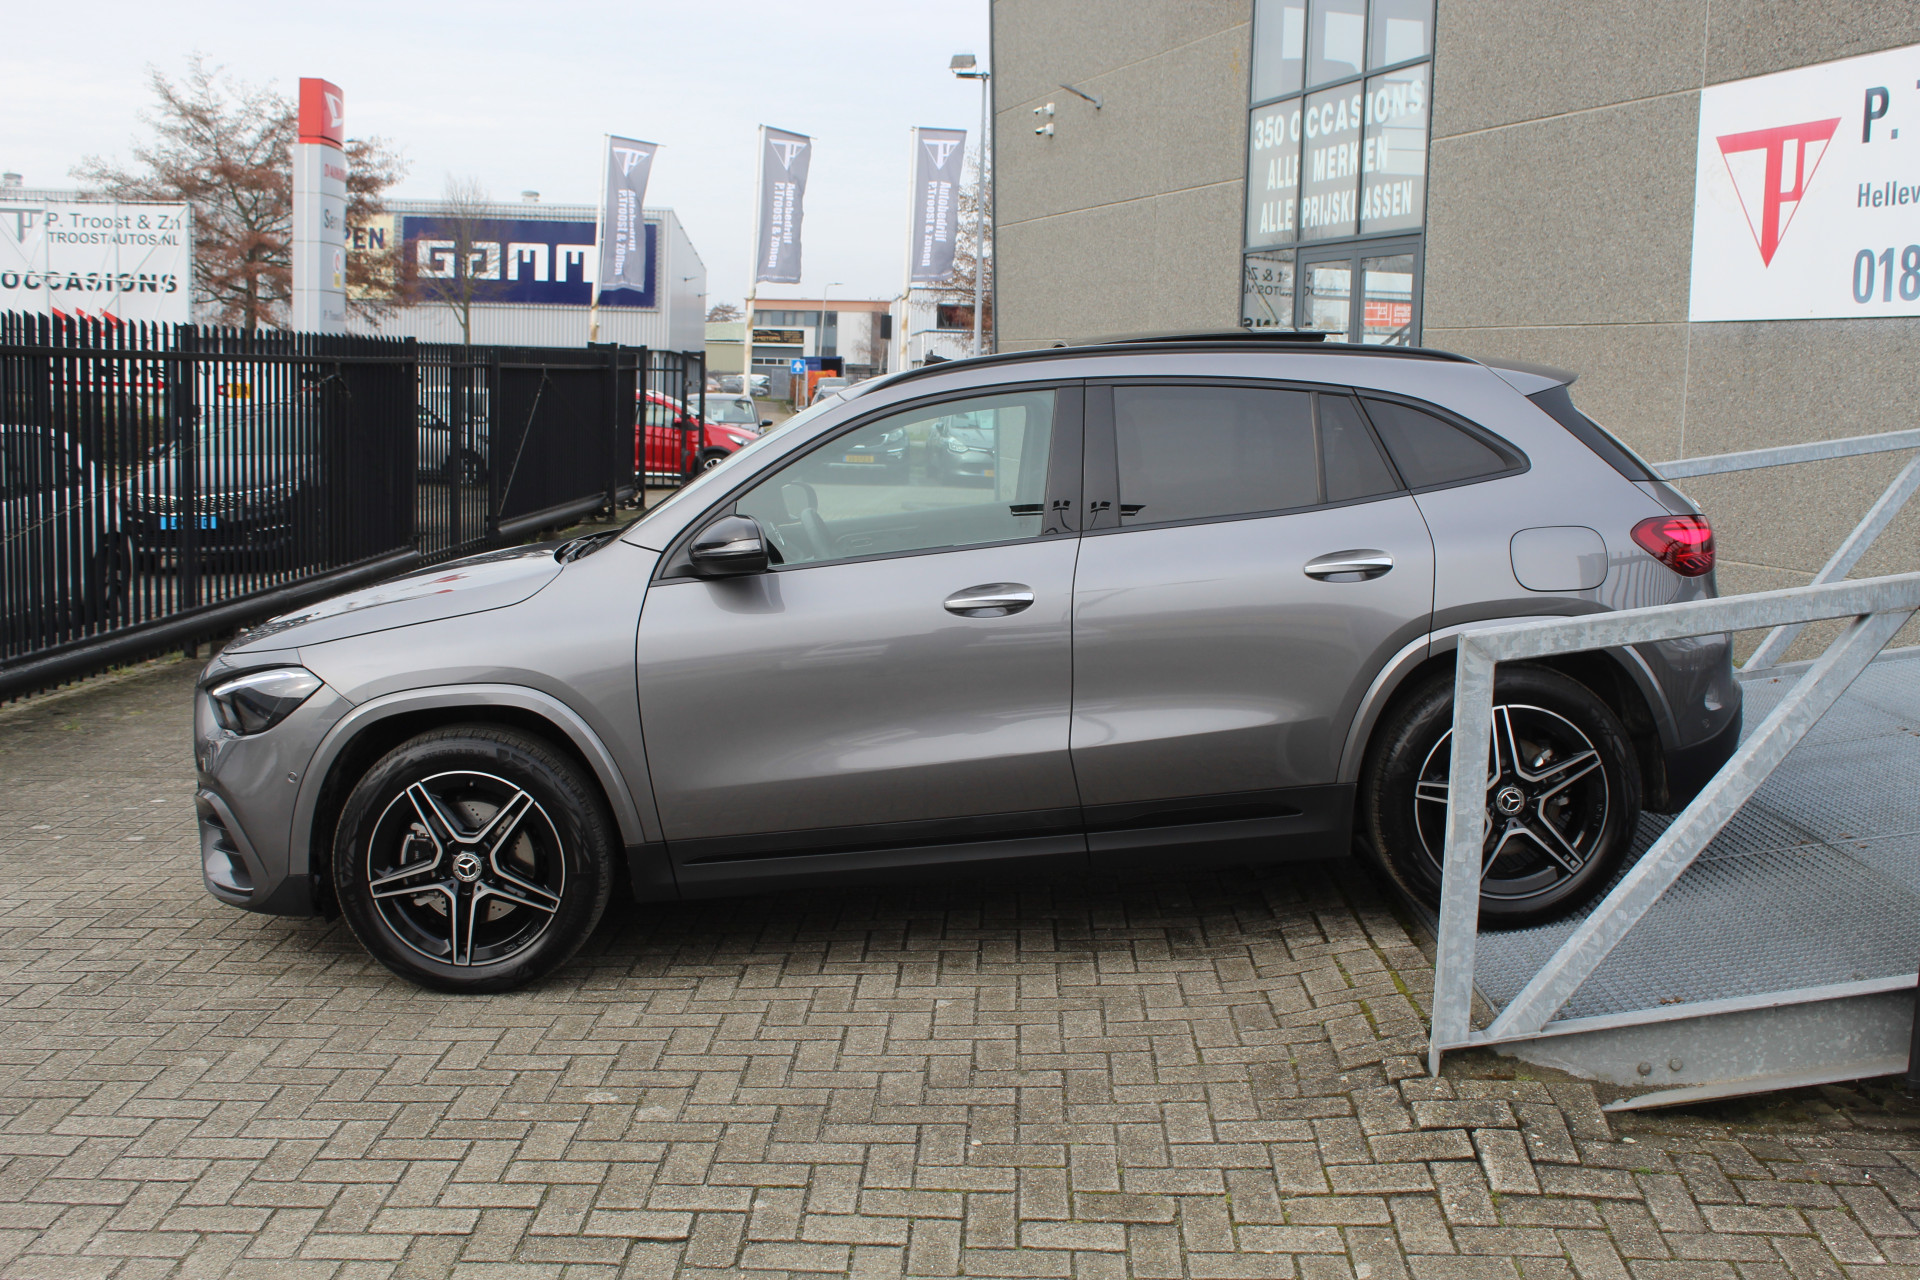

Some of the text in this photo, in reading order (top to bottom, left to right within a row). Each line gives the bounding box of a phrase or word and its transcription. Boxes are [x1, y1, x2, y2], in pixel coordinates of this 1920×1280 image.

[1254, 79, 1423, 150] 350 OCCASIONS
[1862, 86, 1898, 144] P.
[1267, 135, 1388, 190] ALLE MERKEN
[48, 212, 63, 228] P.
[69, 213, 131, 229] Troost
[137, 214, 151, 230] &
[772, 226, 781, 234] &
[783, 182, 796, 244] Autobedrijf
[925, 225, 934, 233] &
[935, 181, 951, 242] Autobedrijf
[1260, 199, 1293, 233] ALLE
[616, 233, 627, 241] &
[1, 269, 178, 293] OCCASIONS
[1853, 244, 1920, 304] 018
